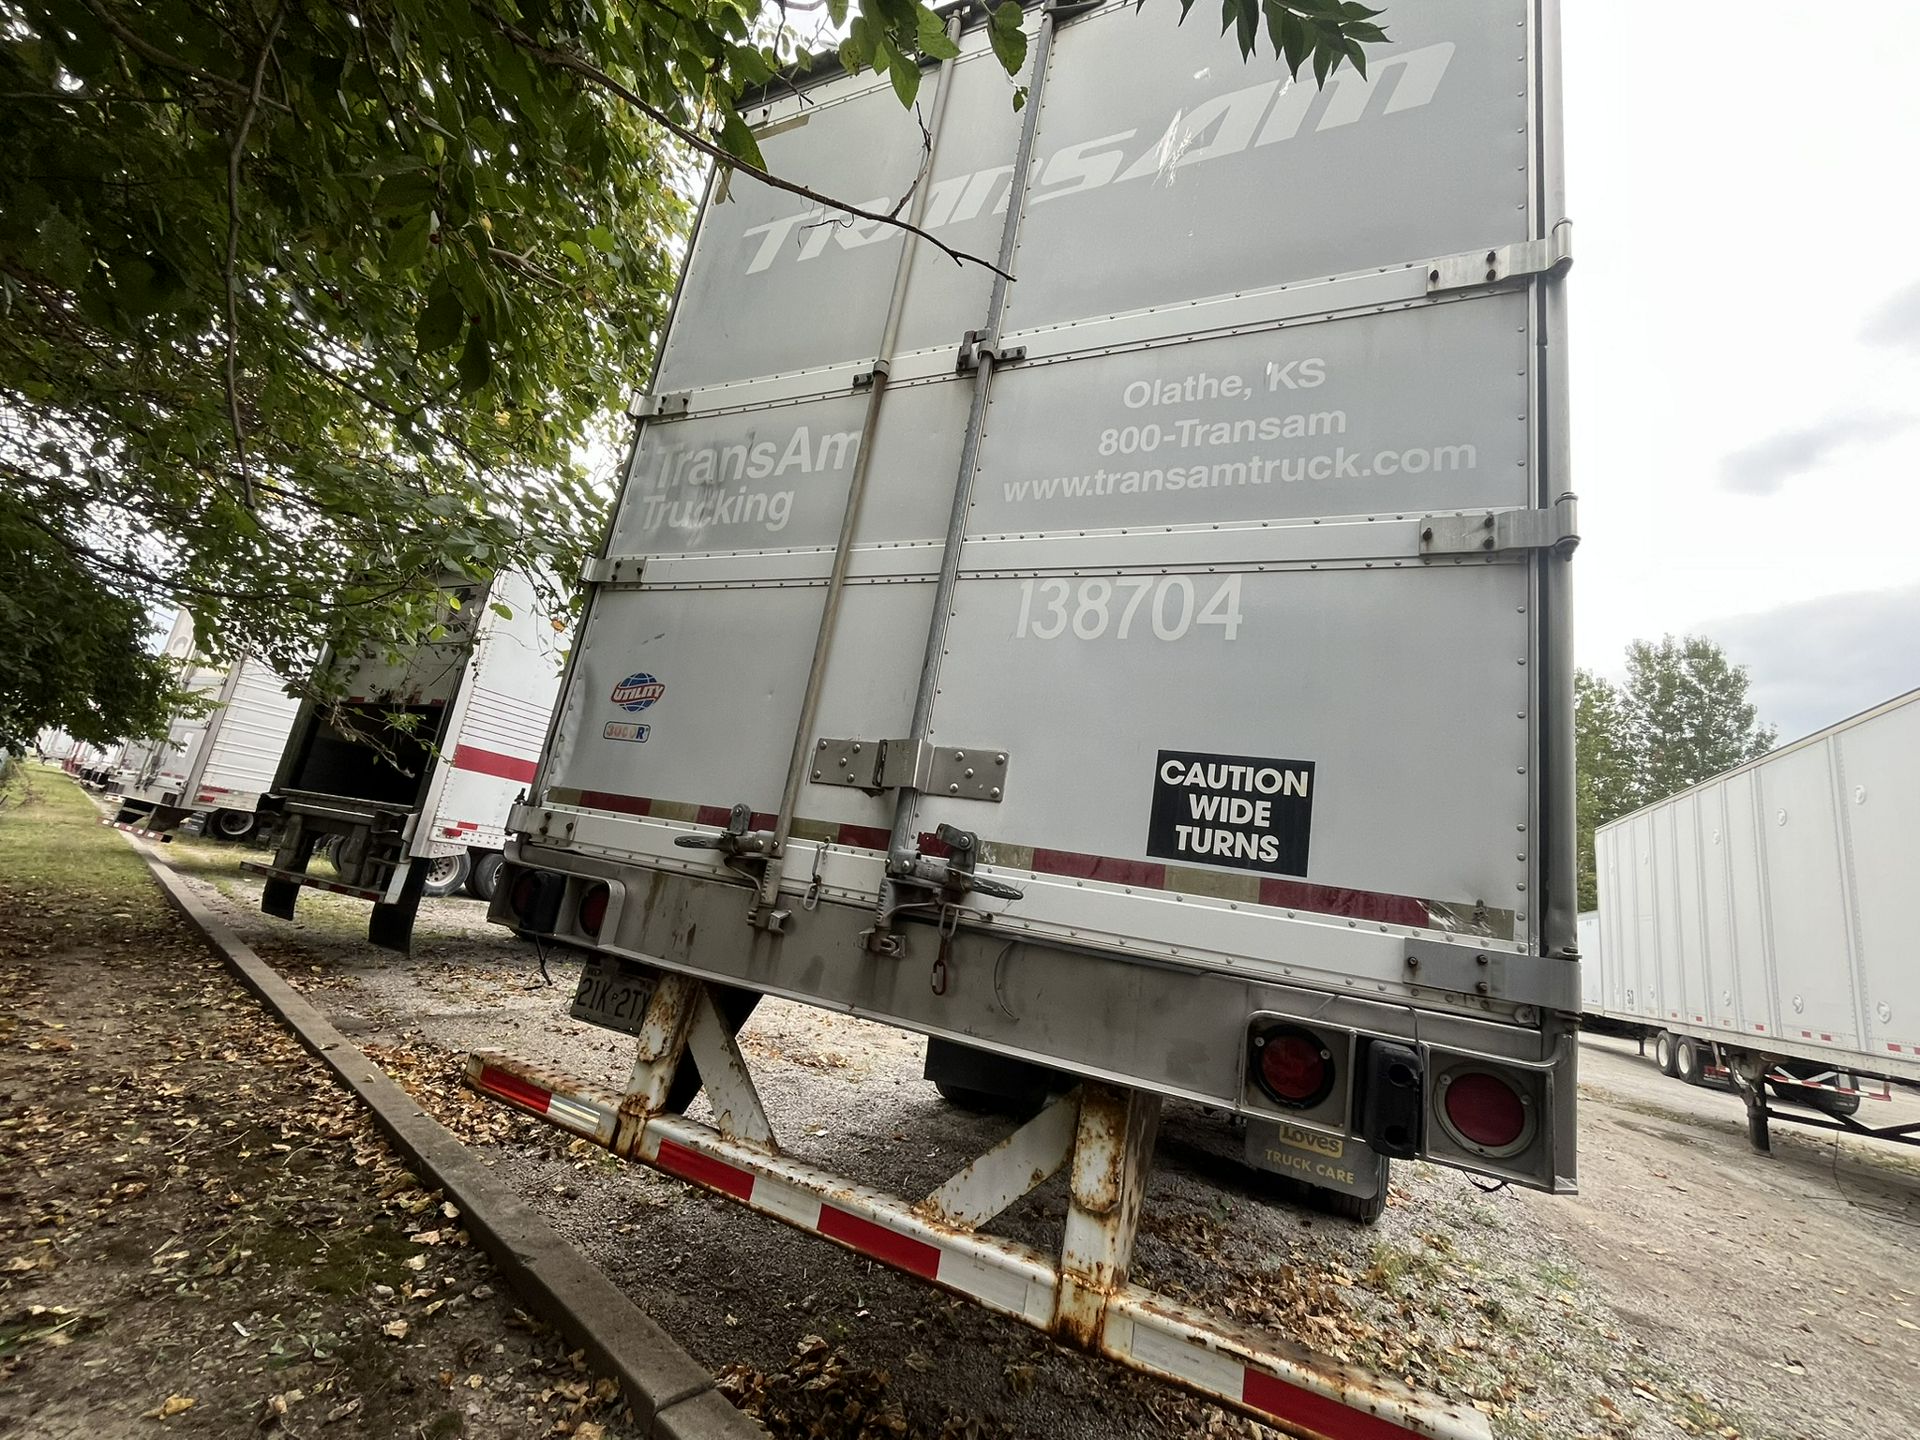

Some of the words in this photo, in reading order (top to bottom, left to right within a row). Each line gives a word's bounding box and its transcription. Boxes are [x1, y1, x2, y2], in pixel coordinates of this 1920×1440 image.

[1122, 373, 1252, 410] Olathe,
[1267, 358, 1326, 391] KS
[1098, 410, 1347, 456] 800-Transam
[655, 426, 862, 488] TransAm
[1003, 443, 1477, 502] www.transamtruck.com
[643, 486, 795, 531] Trucking
[1015, 574, 1243, 641] 138704
[613, 685, 663, 700] UTILITY
[1160, 759, 1308, 797] CAUTION
[1189, 793, 1271, 827] WIDE
[1175, 825, 1279, 862] TURNS
[1264, 1149, 1311, 1172] TRUCK
[1316, 1164, 1354, 1184] CARE
